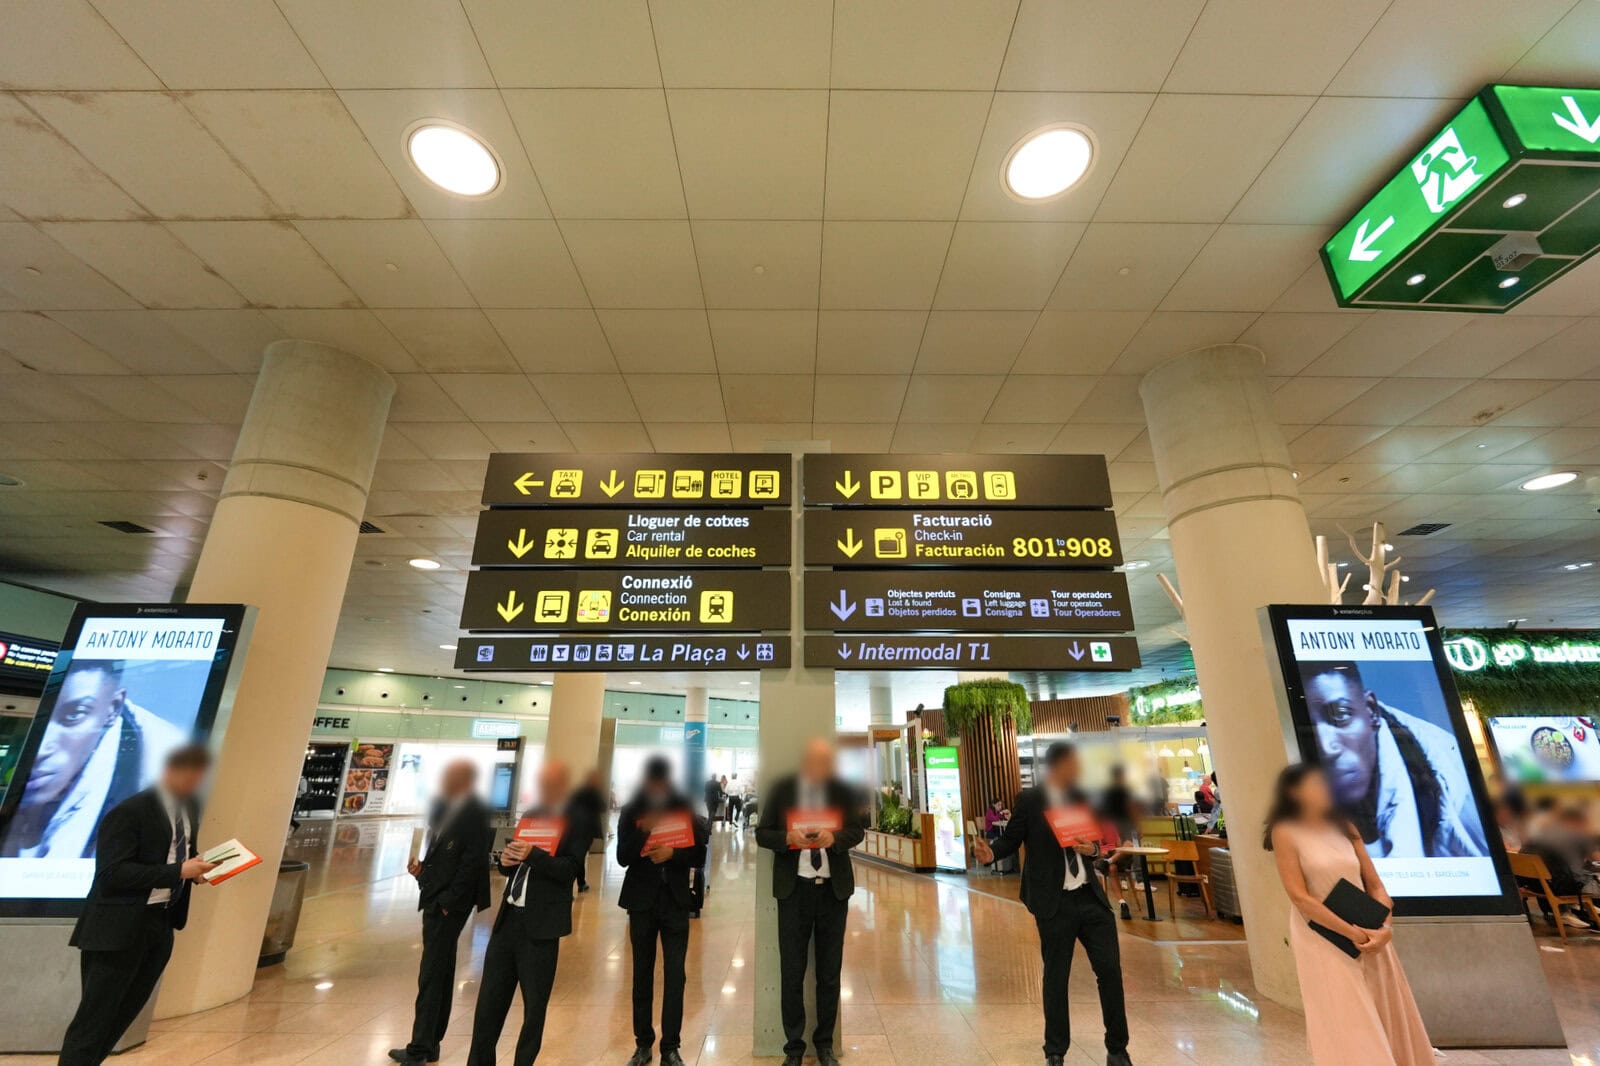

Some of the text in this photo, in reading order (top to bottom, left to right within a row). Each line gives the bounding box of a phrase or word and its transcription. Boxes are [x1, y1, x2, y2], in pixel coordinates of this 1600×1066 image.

[915, 473, 931, 481] VIP
[878, 475, 894, 494] P
[917, 482, 930, 496] P
[627, 514, 750, 530] Lloguer de cotxes
[913, 513, 993, 527] Facturació
[627, 530, 685, 541] Car rental
[914, 529, 963, 541] Check-in
[626, 544, 757, 560] Alquiler de coches
[915, 543, 1005, 557] Facturación
[1012, 537, 1113, 557] 801 to 908
[621, 575, 693, 589] Connexió
[620, 592, 687, 604] Connection
[887, 589, 956, 599] Objectes perduts
[983, 590, 1021, 600] Consigna
[1050, 590, 1113, 600] Tour operadors
[999, 600, 1027, 608] luggage
[1070, 600, 1103, 608] operators
[618, 607, 691, 622] Conexión
[888, 608, 957, 617] Objetos perdidos
[985, 608, 1023, 617] Consigna
[1053, 608, 1121, 618] Tour Operadores
[86, 630, 213, 649] ANTONY MORATO
[1300, 631, 1420, 650] ANTONY MORATO
[639, 643, 727, 666] La Plaça
[858, 642, 991, 660] Intermodal T1
[1491, 643, 1525, 666] go
